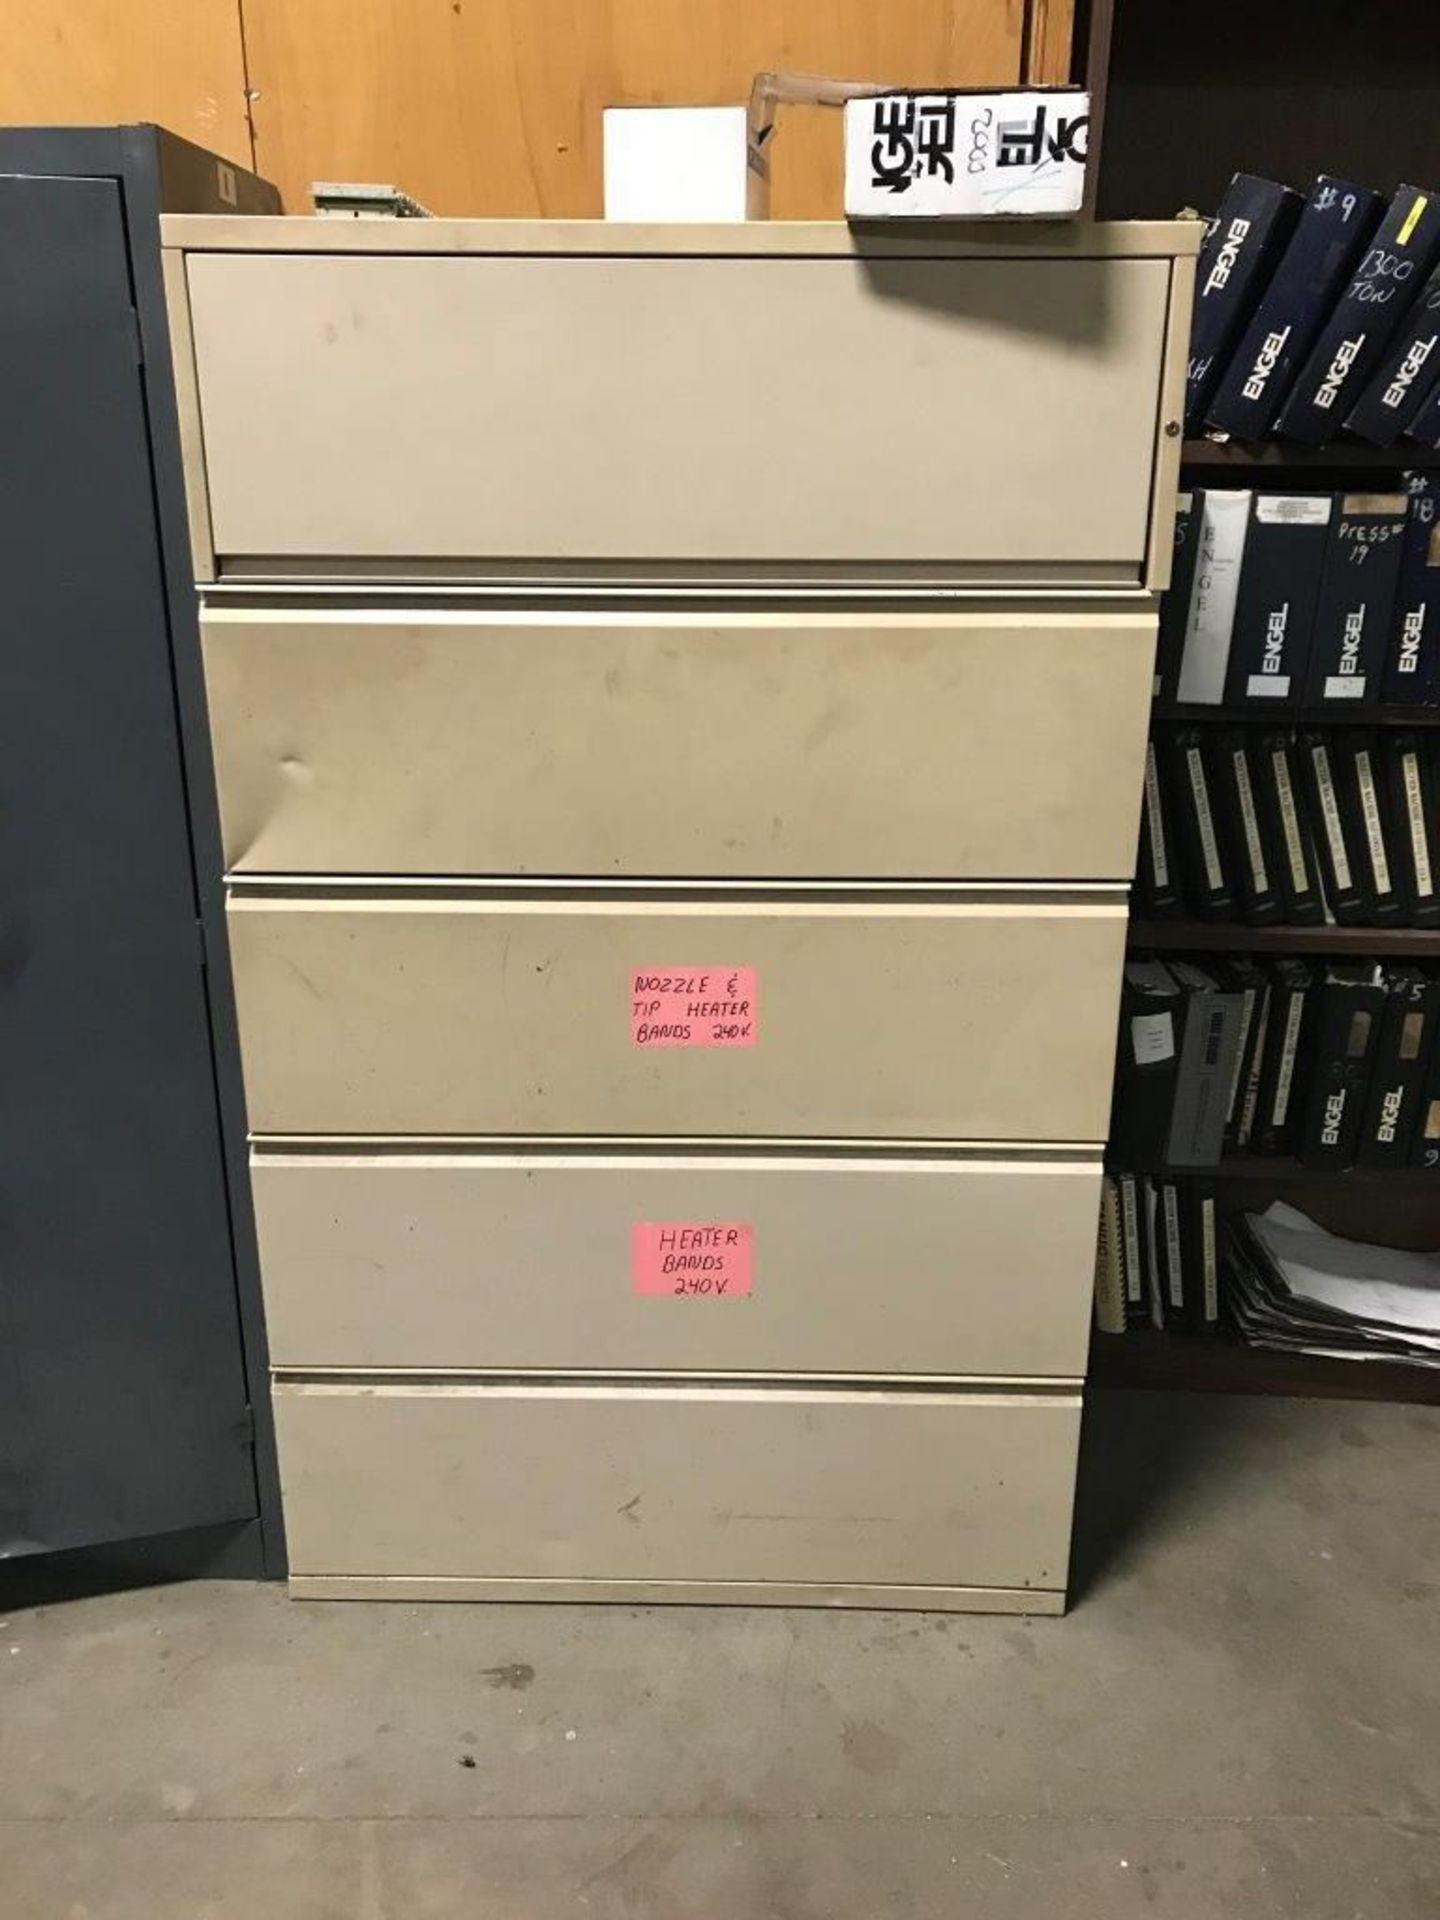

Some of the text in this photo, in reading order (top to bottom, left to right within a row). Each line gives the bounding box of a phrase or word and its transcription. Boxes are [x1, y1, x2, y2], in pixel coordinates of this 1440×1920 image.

[1202, 218, 1251, 297] ENGEL
[1358, 249, 1414, 281] 1300
[1347, 281, 1395, 303] TON
[1242, 326, 1291, 400] ENGEL
[1314, 333, 1366, 409] ENGEL
[1382, 335, 1438, 409] ENGEL
[1262, 603, 1289, 673] ENGEL
[1339, 603, 1365, 674] ENGEL
[1398, 603, 1425, 672] ENGEL
[633, 1000, 750, 1017] TIP HEATER
[635, 976, 710, 994] NOZZLE
[636, 1023, 691, 1043] BANDS
[1321, 1089, 1346, 1145] ENGEL
[1377, 1085, 1404, 1143] ENGEL
[659, 1227, 738, 1251] HEATER
[662, 1254, 723, 1273] BANDS
